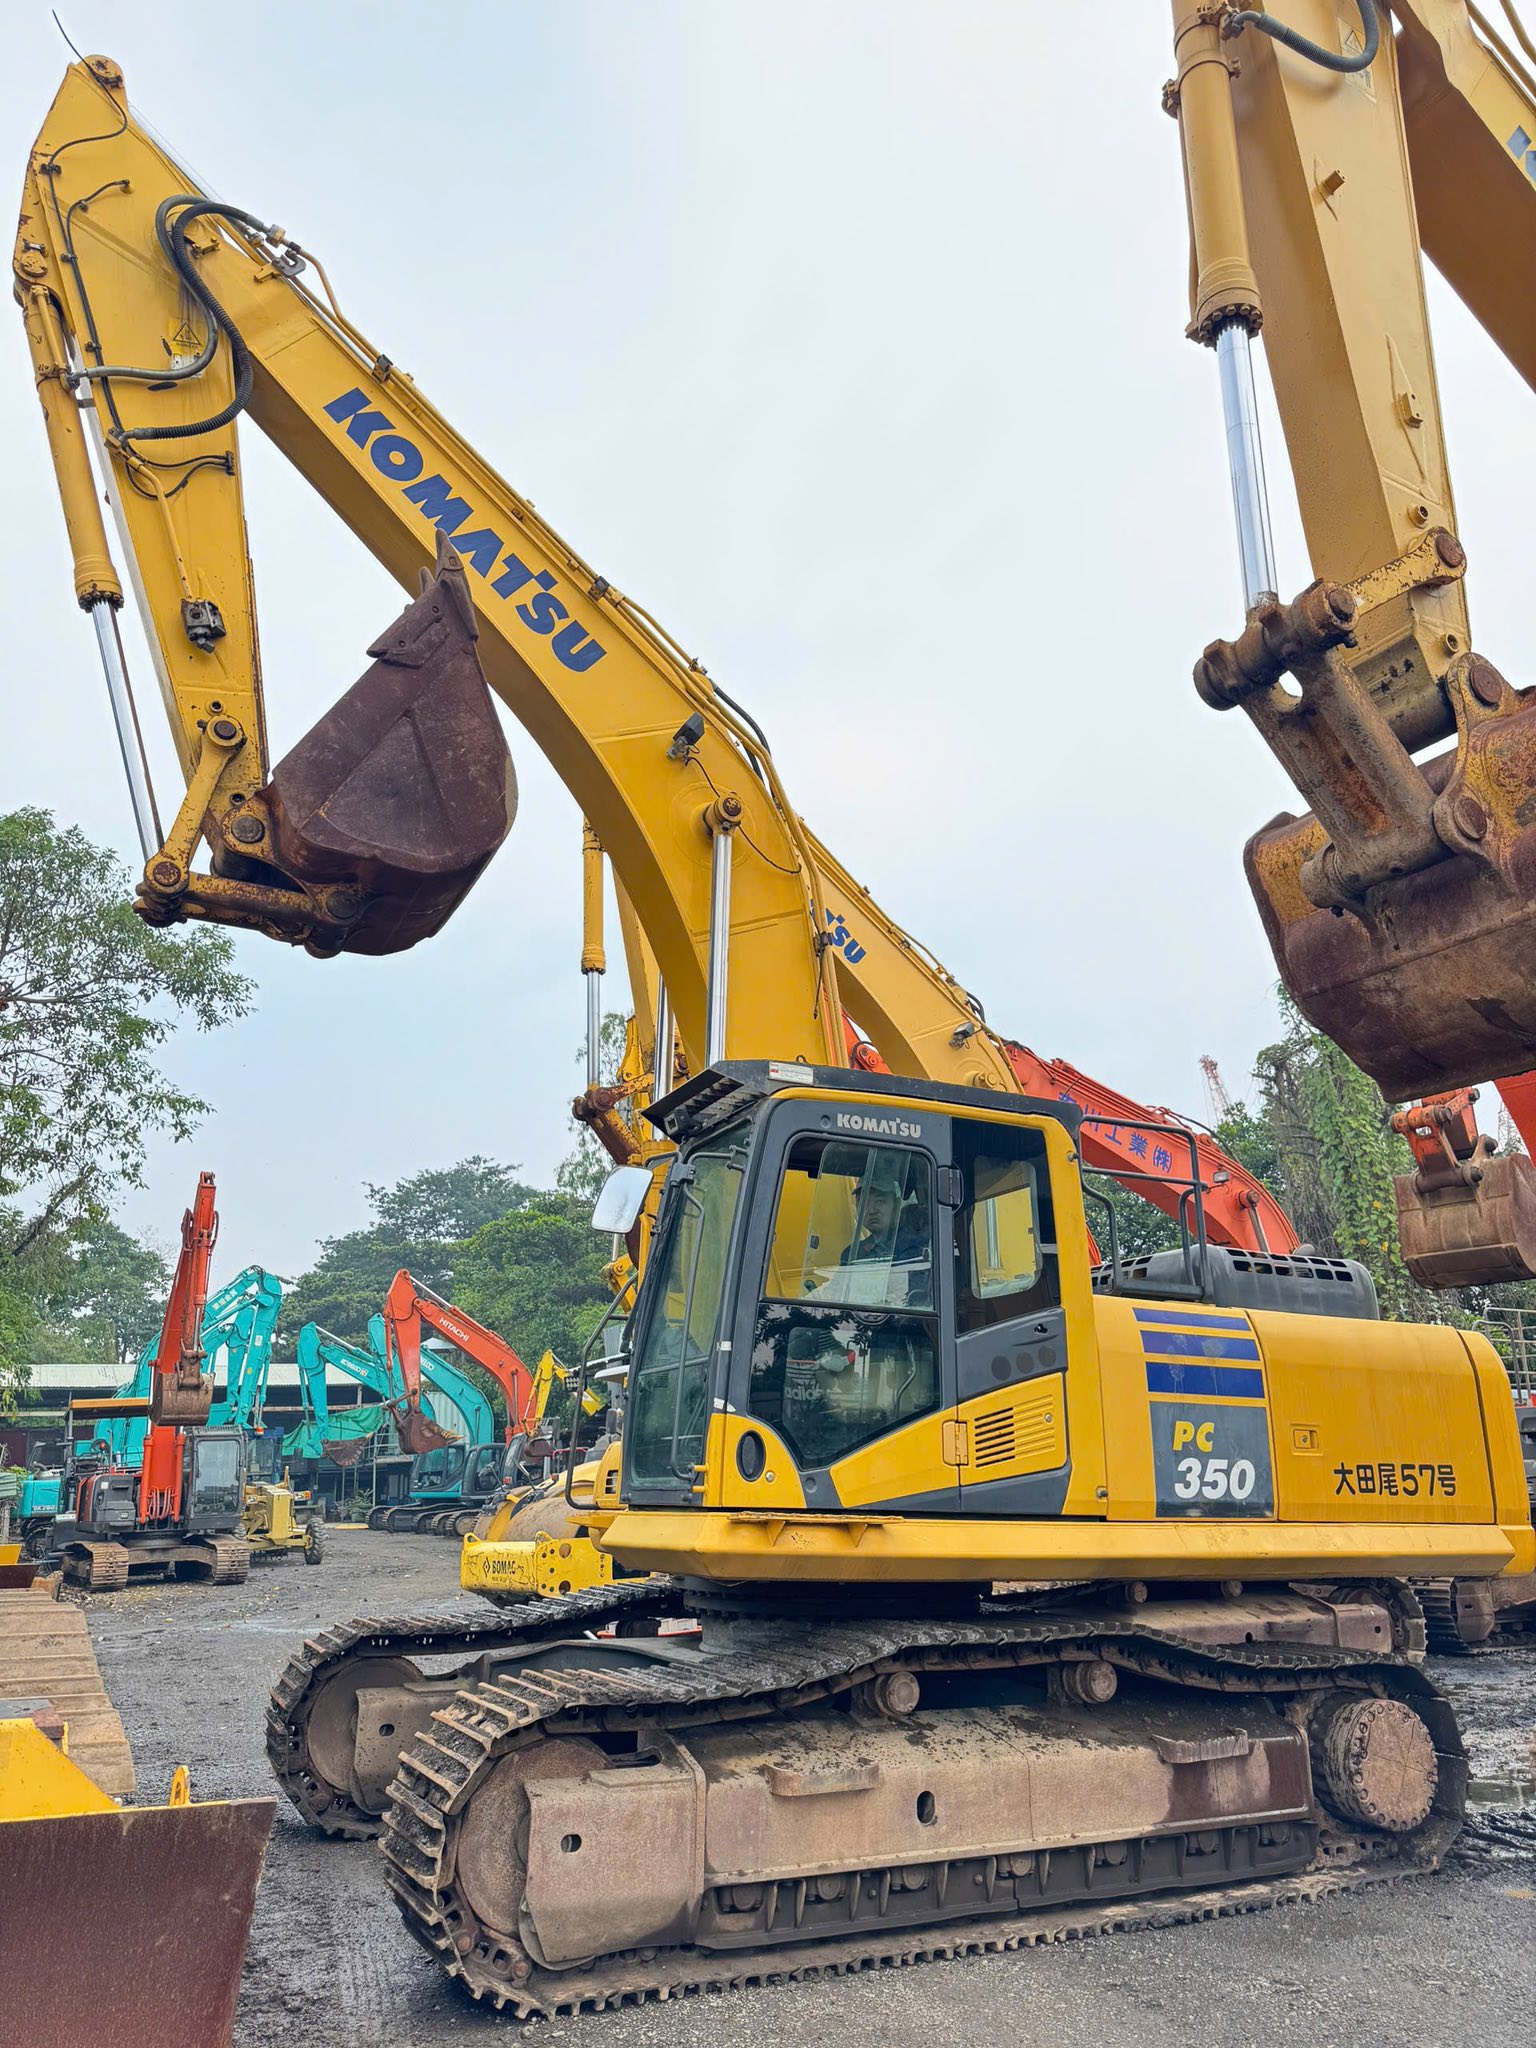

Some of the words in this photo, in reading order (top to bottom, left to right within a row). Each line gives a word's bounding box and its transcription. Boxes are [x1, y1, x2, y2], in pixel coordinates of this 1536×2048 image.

[322, 386, 608, 673] KOMATSU
[837, 1113, 922, 1139] KOMATSU
[439, 1317, 469, 1342] HITACHI
[1172, 1420, 1215, 1453] PC
[1174, 1457, 1256, 1500] 350
[1333, 1461, 1457, 1497] 大田尾57号
